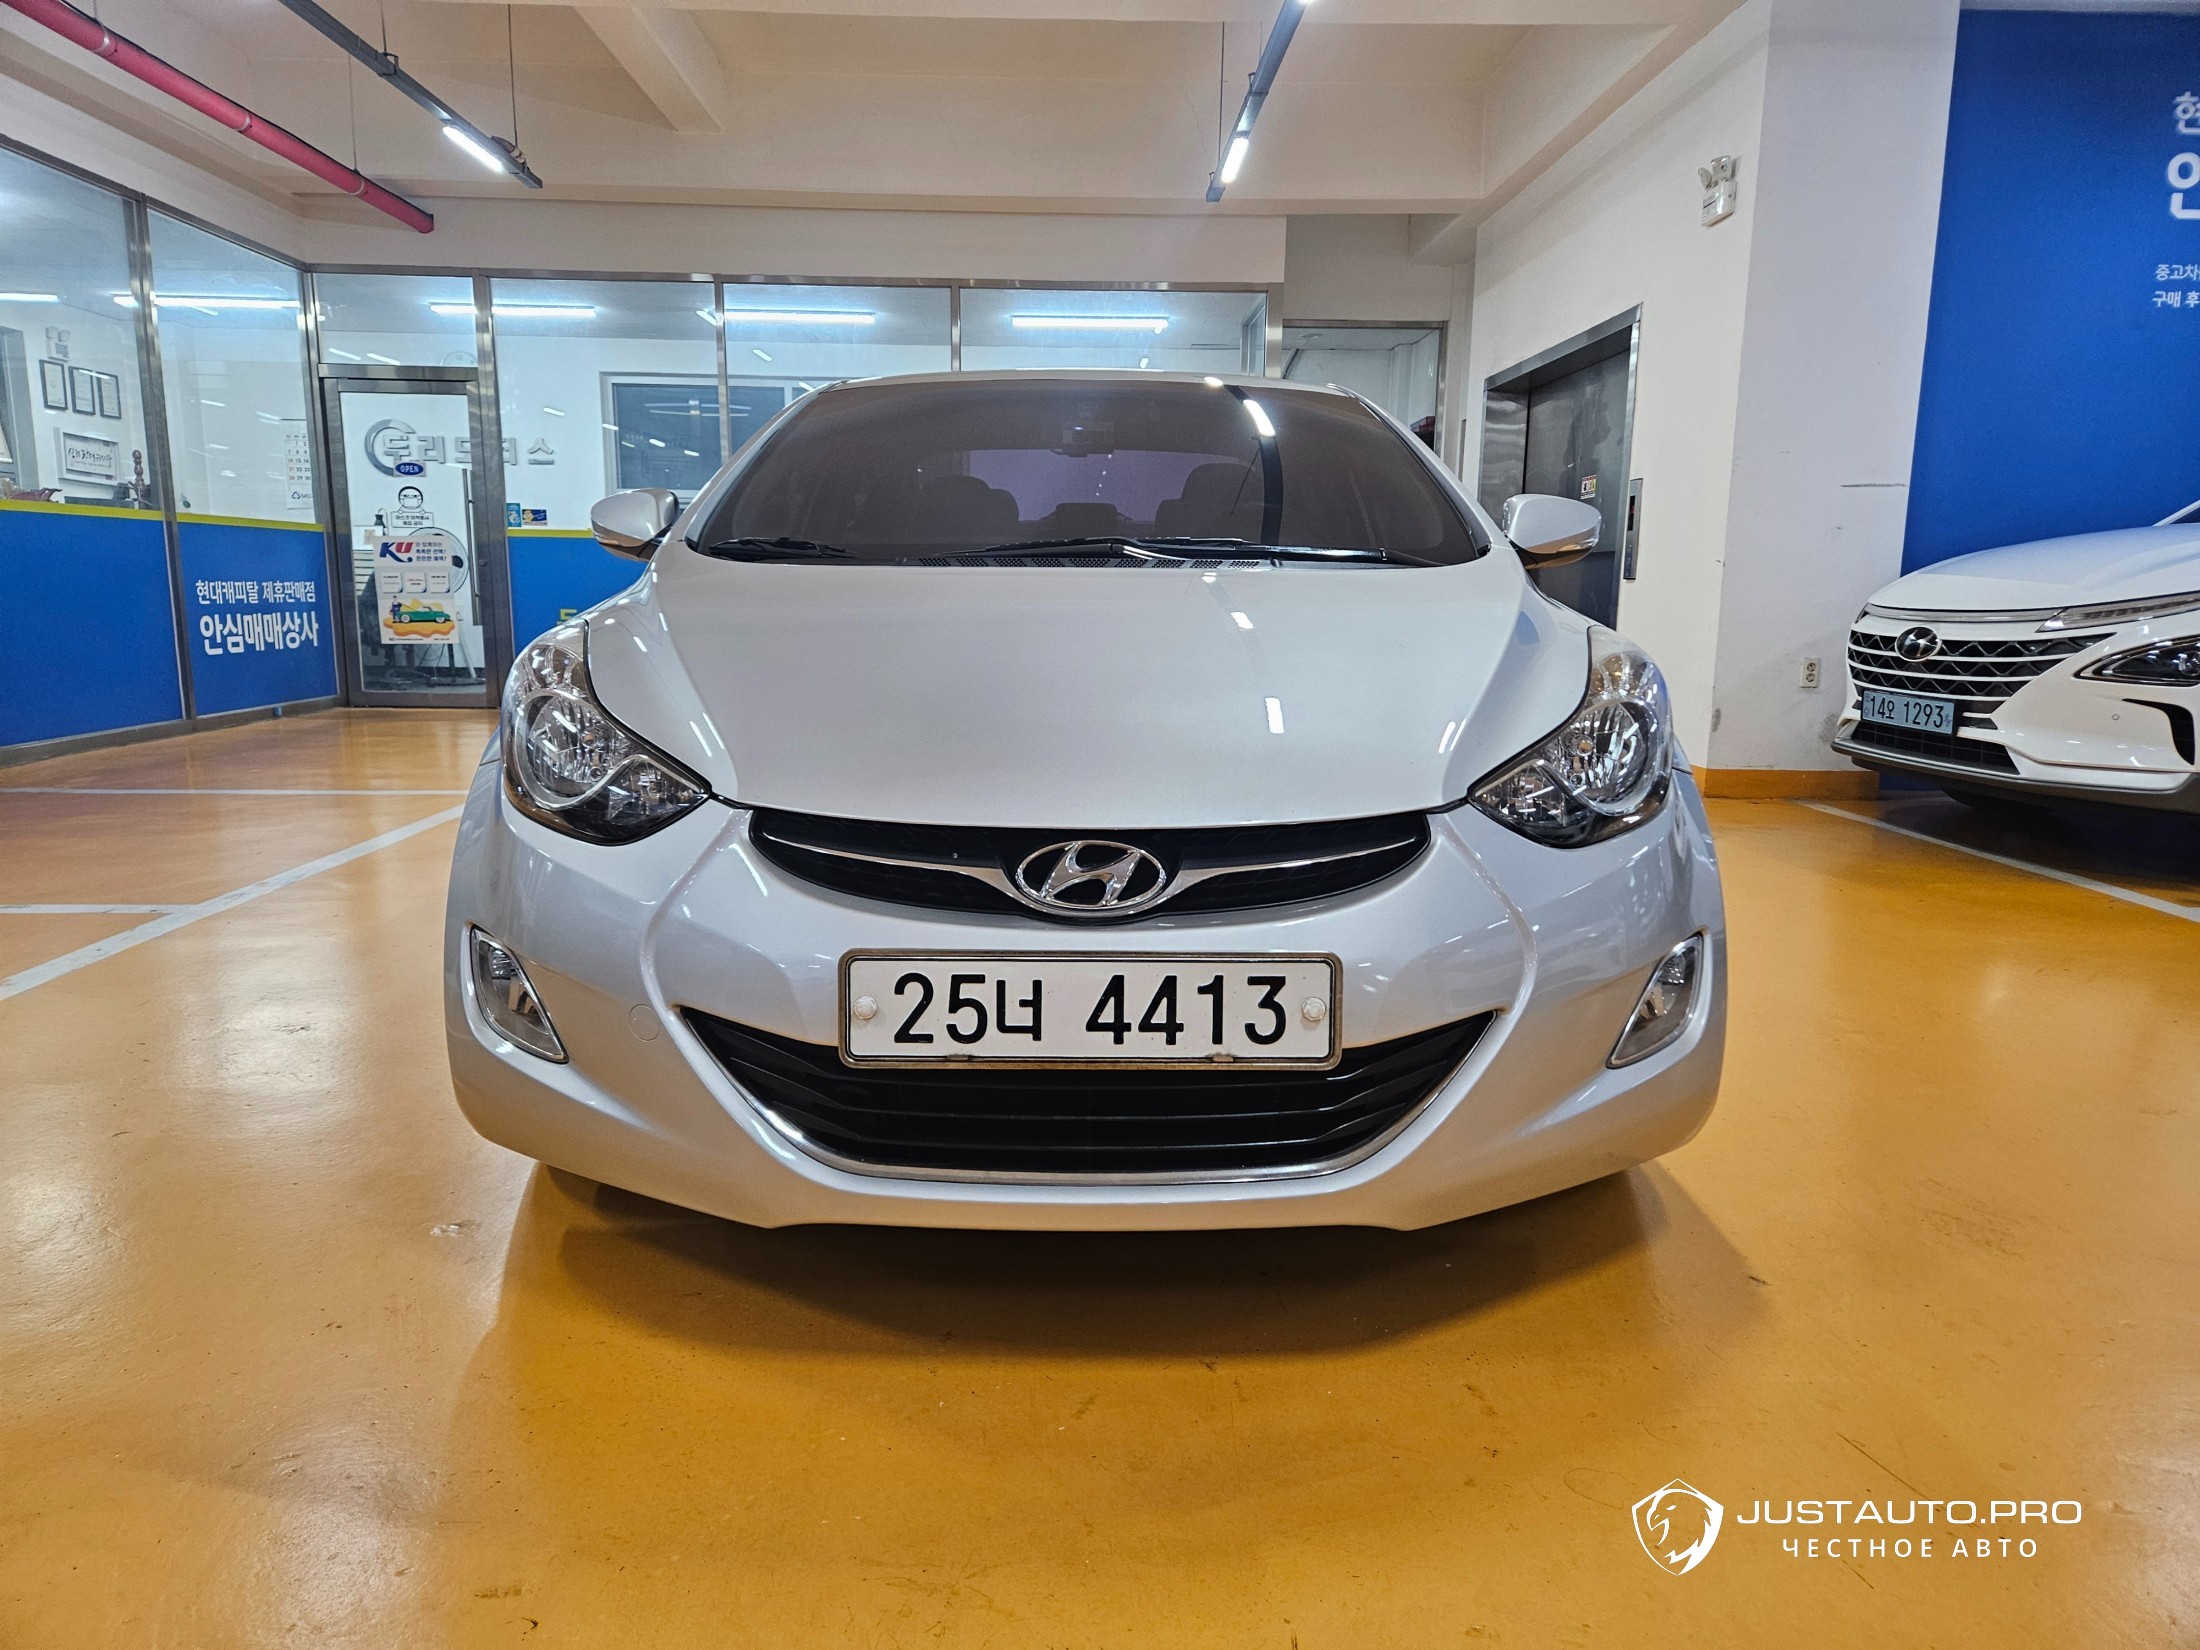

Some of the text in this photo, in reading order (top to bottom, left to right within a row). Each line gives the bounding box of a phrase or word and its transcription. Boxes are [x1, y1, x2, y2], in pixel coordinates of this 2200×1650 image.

[2155, 264, 2200, 280] 중고차
[2153, 291, 2200, 307] 구매 후
[400, 465, 419, 473] OPEN
[196, 580, 315, 604] 현대캐피탈 제휴판매점
[200, 611, 319, 655] 안심매매상사
[1871, 696, 1895, 719] 14오
[1904, 701, 1944, 728] 1293
[894, 972, 1287, 1045] 25너 4413
